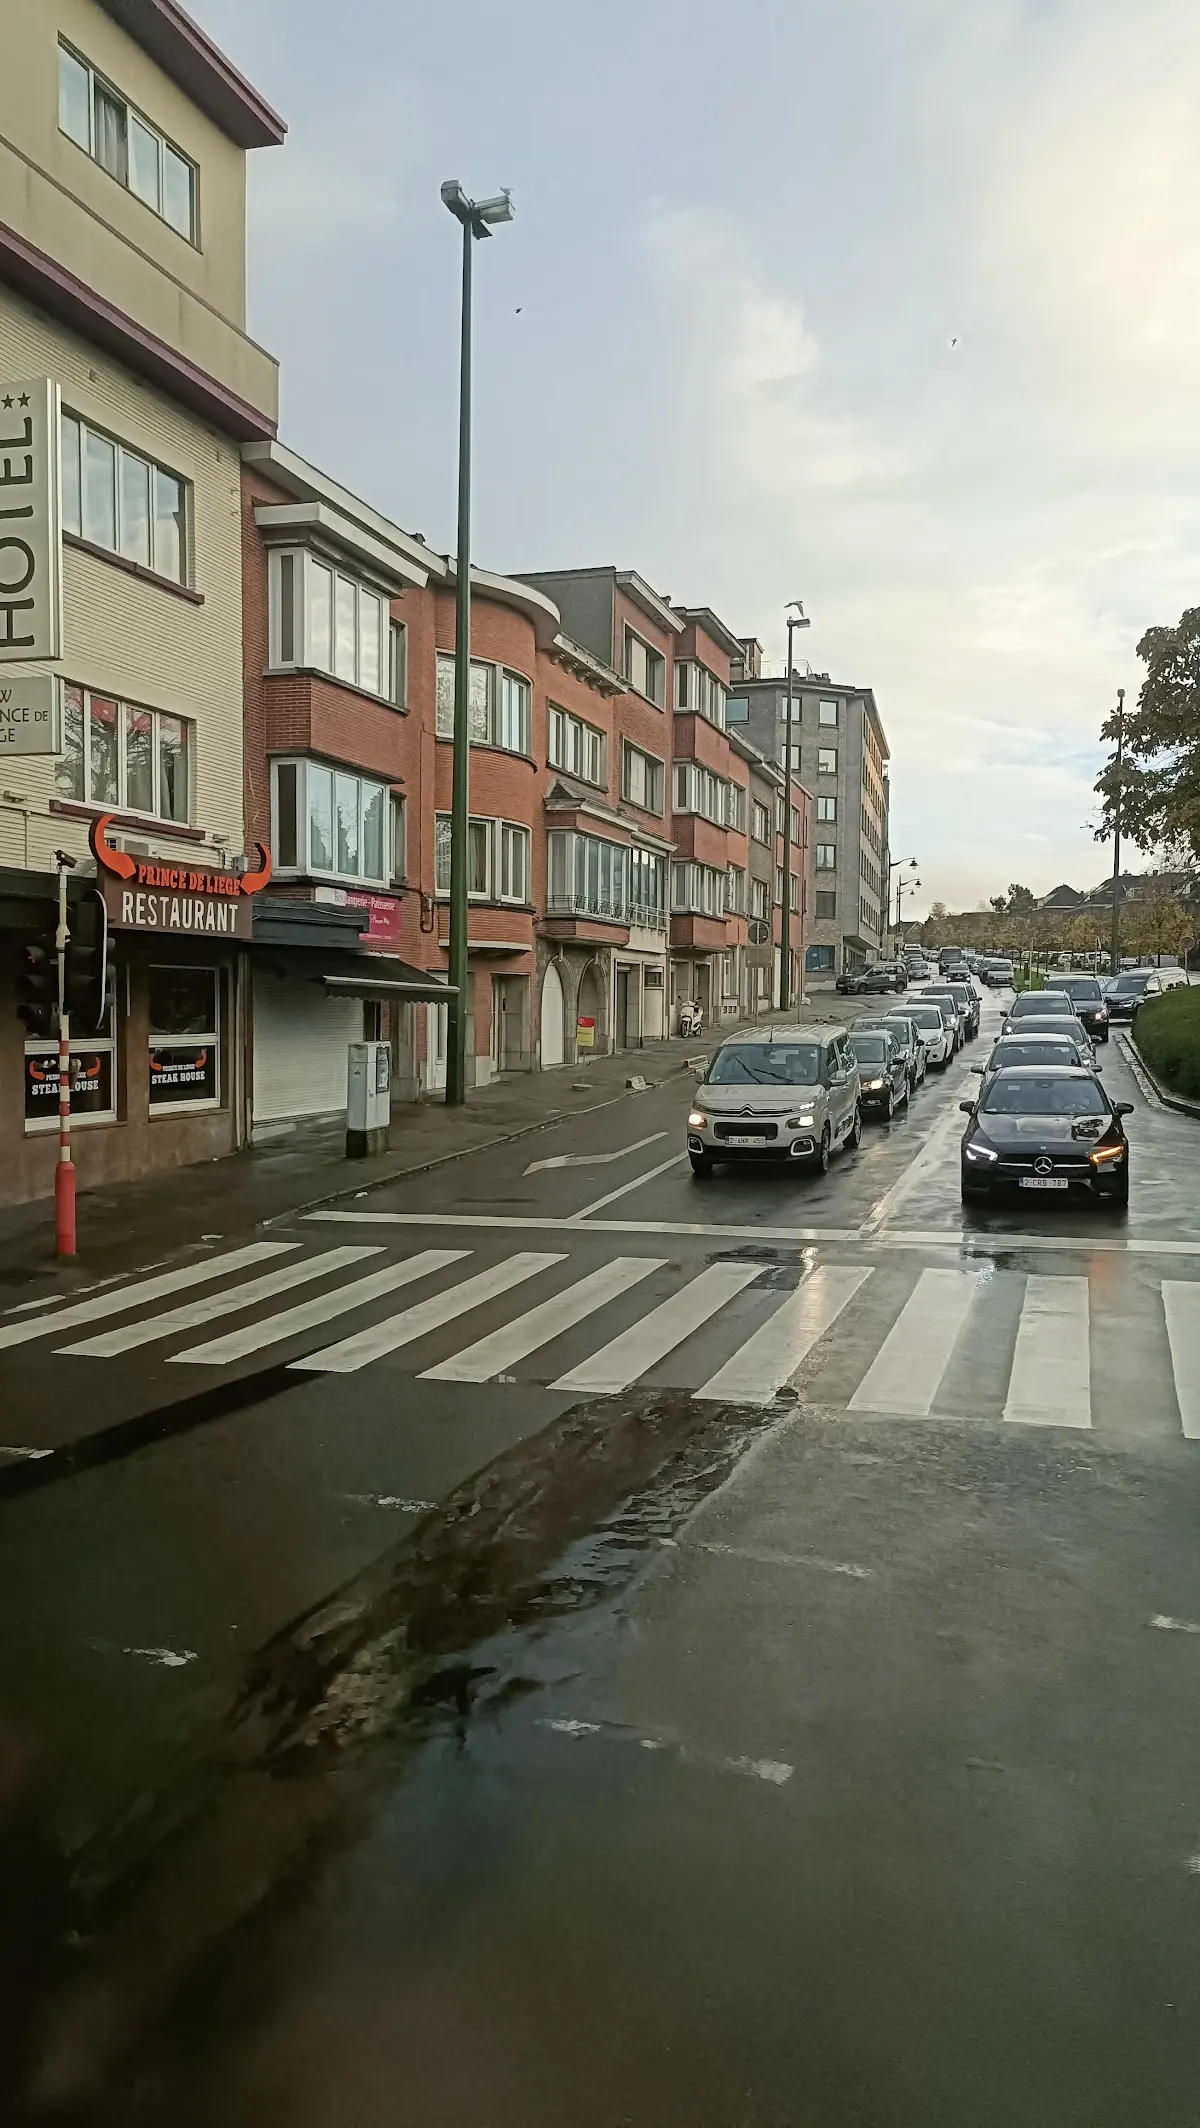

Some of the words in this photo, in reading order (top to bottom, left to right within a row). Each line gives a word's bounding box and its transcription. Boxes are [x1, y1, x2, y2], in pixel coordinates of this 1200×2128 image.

[34, 710, 49, 722] DE
[138, 864, 187, 890] PRINCE
[188, 872, 205, 892] DE
[206, 874, 241, 897] LIEGE
[121, 890, 239, 933] RESTAURANT
[151, 1073, 179, 1085] STEAK
[180, 1070, 206, 1082] HOUSE
[74, 1080, 99, 1092] OUSE
